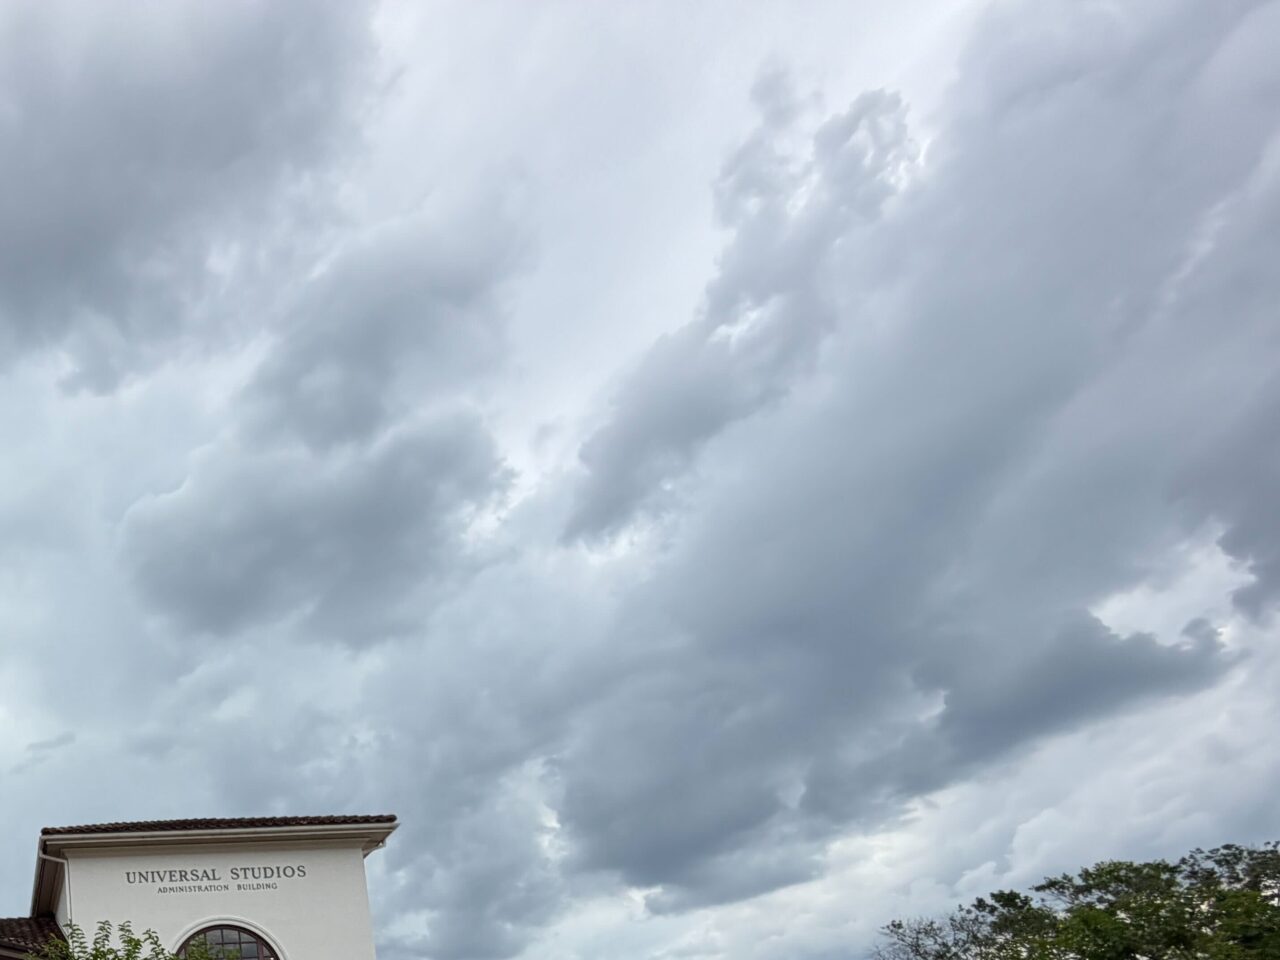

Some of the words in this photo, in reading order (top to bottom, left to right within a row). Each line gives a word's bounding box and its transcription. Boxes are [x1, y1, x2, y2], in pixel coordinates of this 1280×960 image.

[125, 868, 221, 884] UNIVERSAL
[230, 865, 307, 880] STUDIOS
[157, 884, 229, 894] ADMINISTRATION
[237, 882, 278, 892] BUILDING
